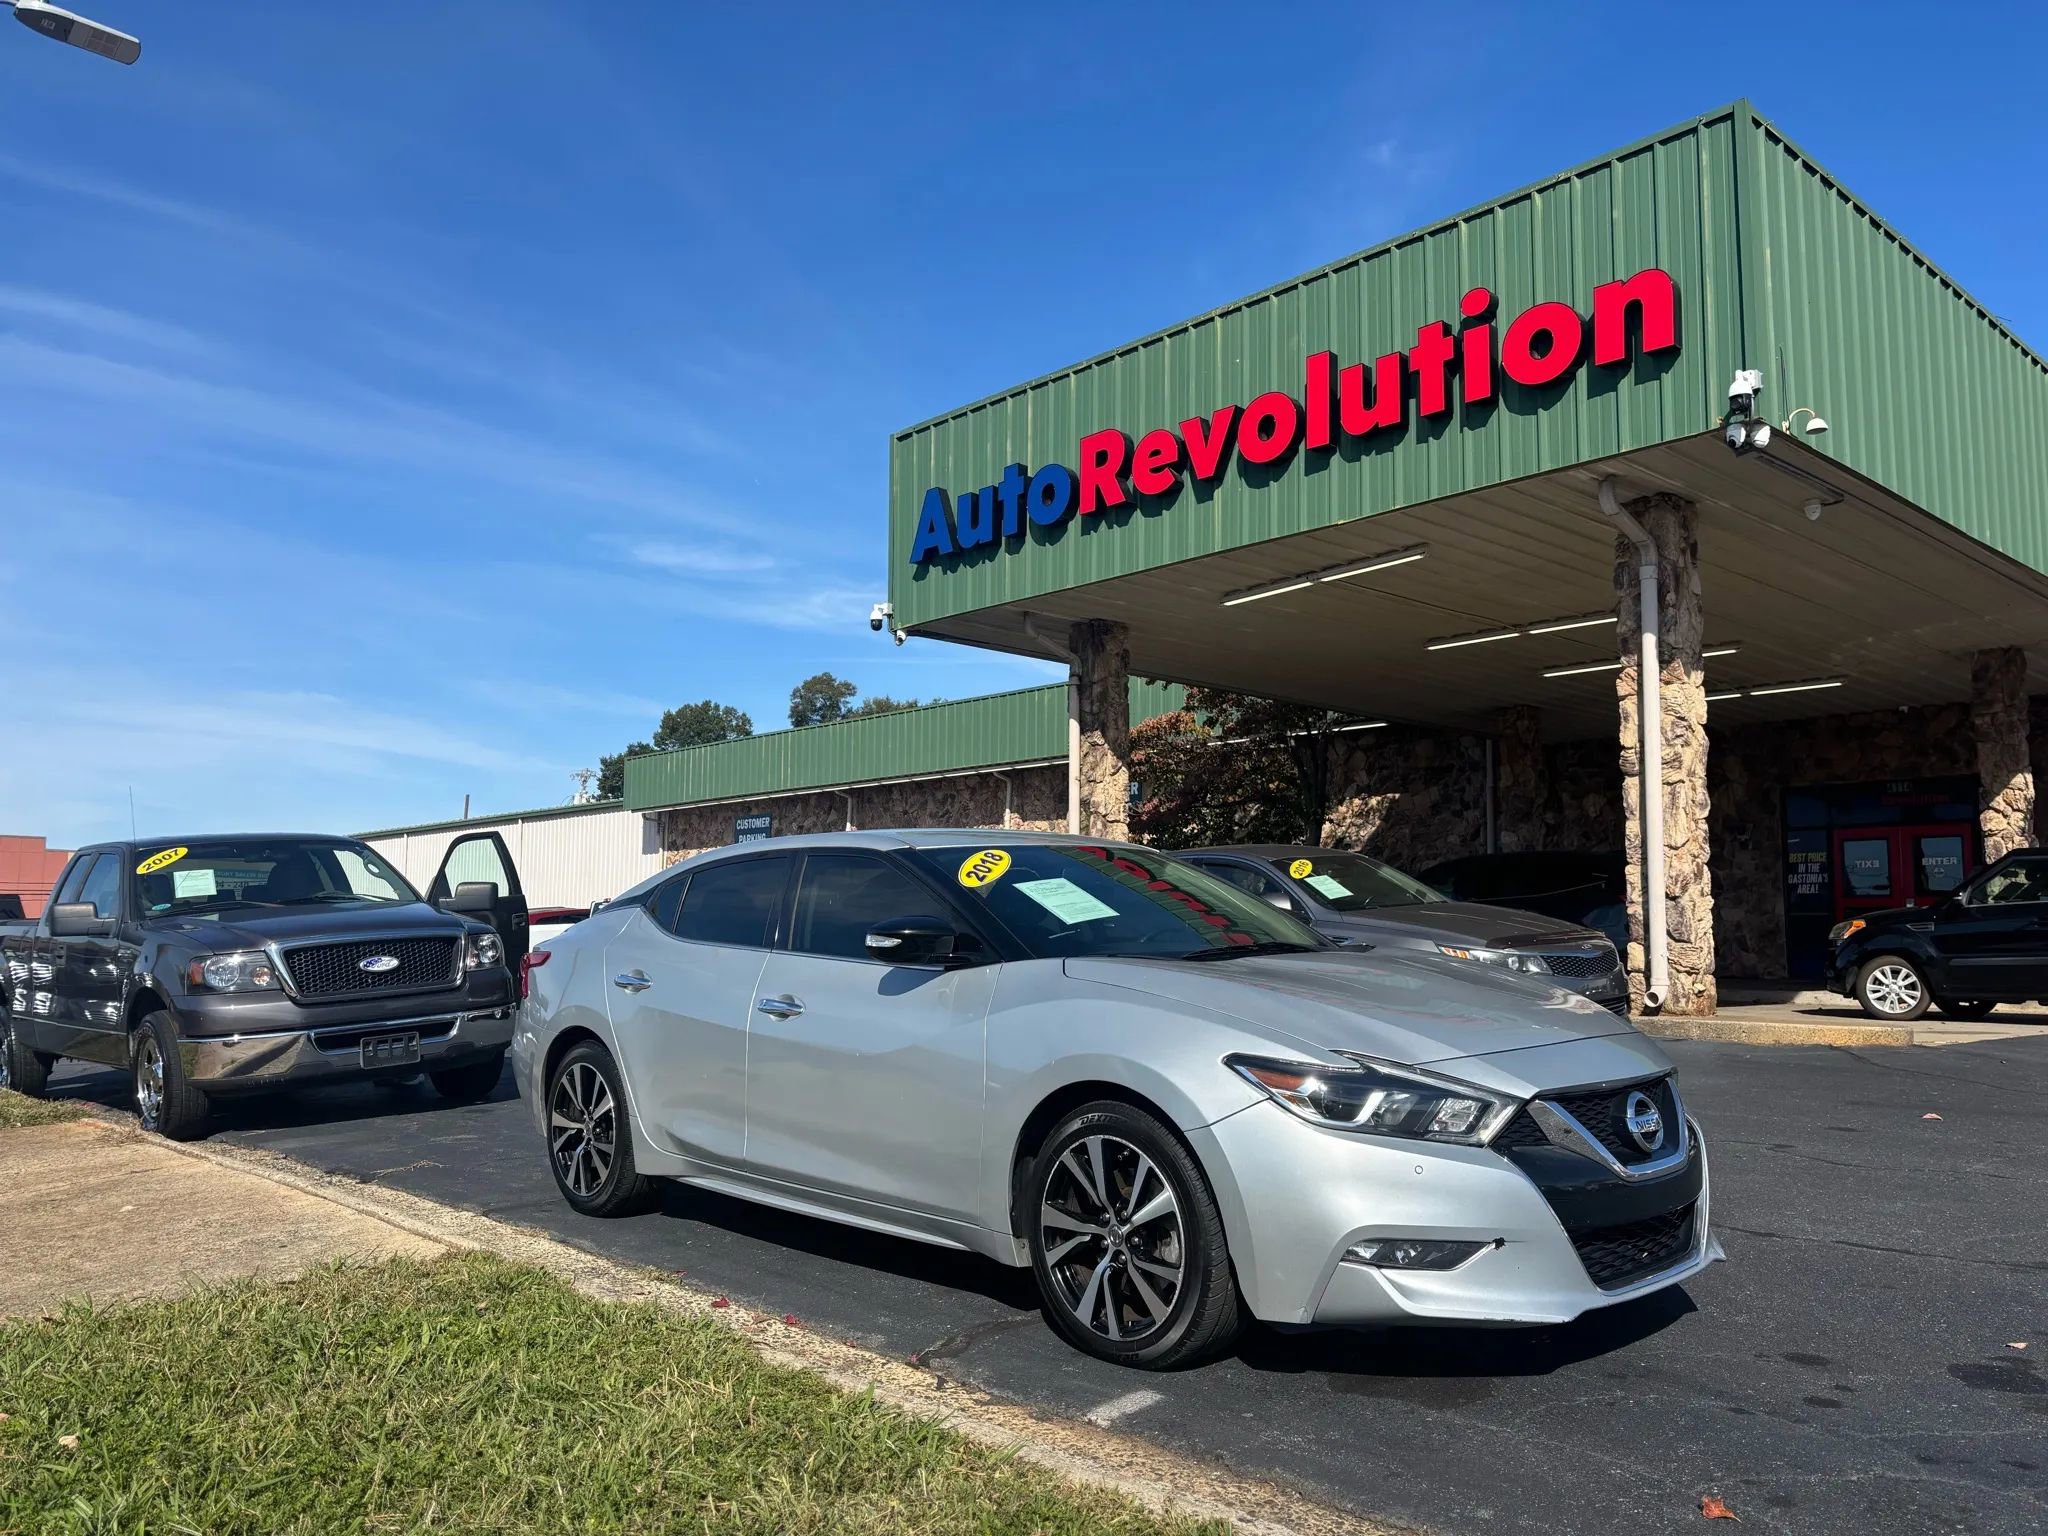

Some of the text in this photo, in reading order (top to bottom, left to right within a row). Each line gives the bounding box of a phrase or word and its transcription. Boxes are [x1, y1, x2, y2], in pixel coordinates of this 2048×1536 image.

[736, 817, 770, 830] CUSTOMER
[143, 848, 181, 871] 2007
[1788, 851, 1827, 863] BEST PRICE
[1921, 856, 1958, 866] ENTER
[966, 851, 1004, 882] 2018
[1293, 860, 1310, 876] 2016
[1798, 862, 1821, 873] IN THE
[1797, 883, 1819, 895] AREA!
